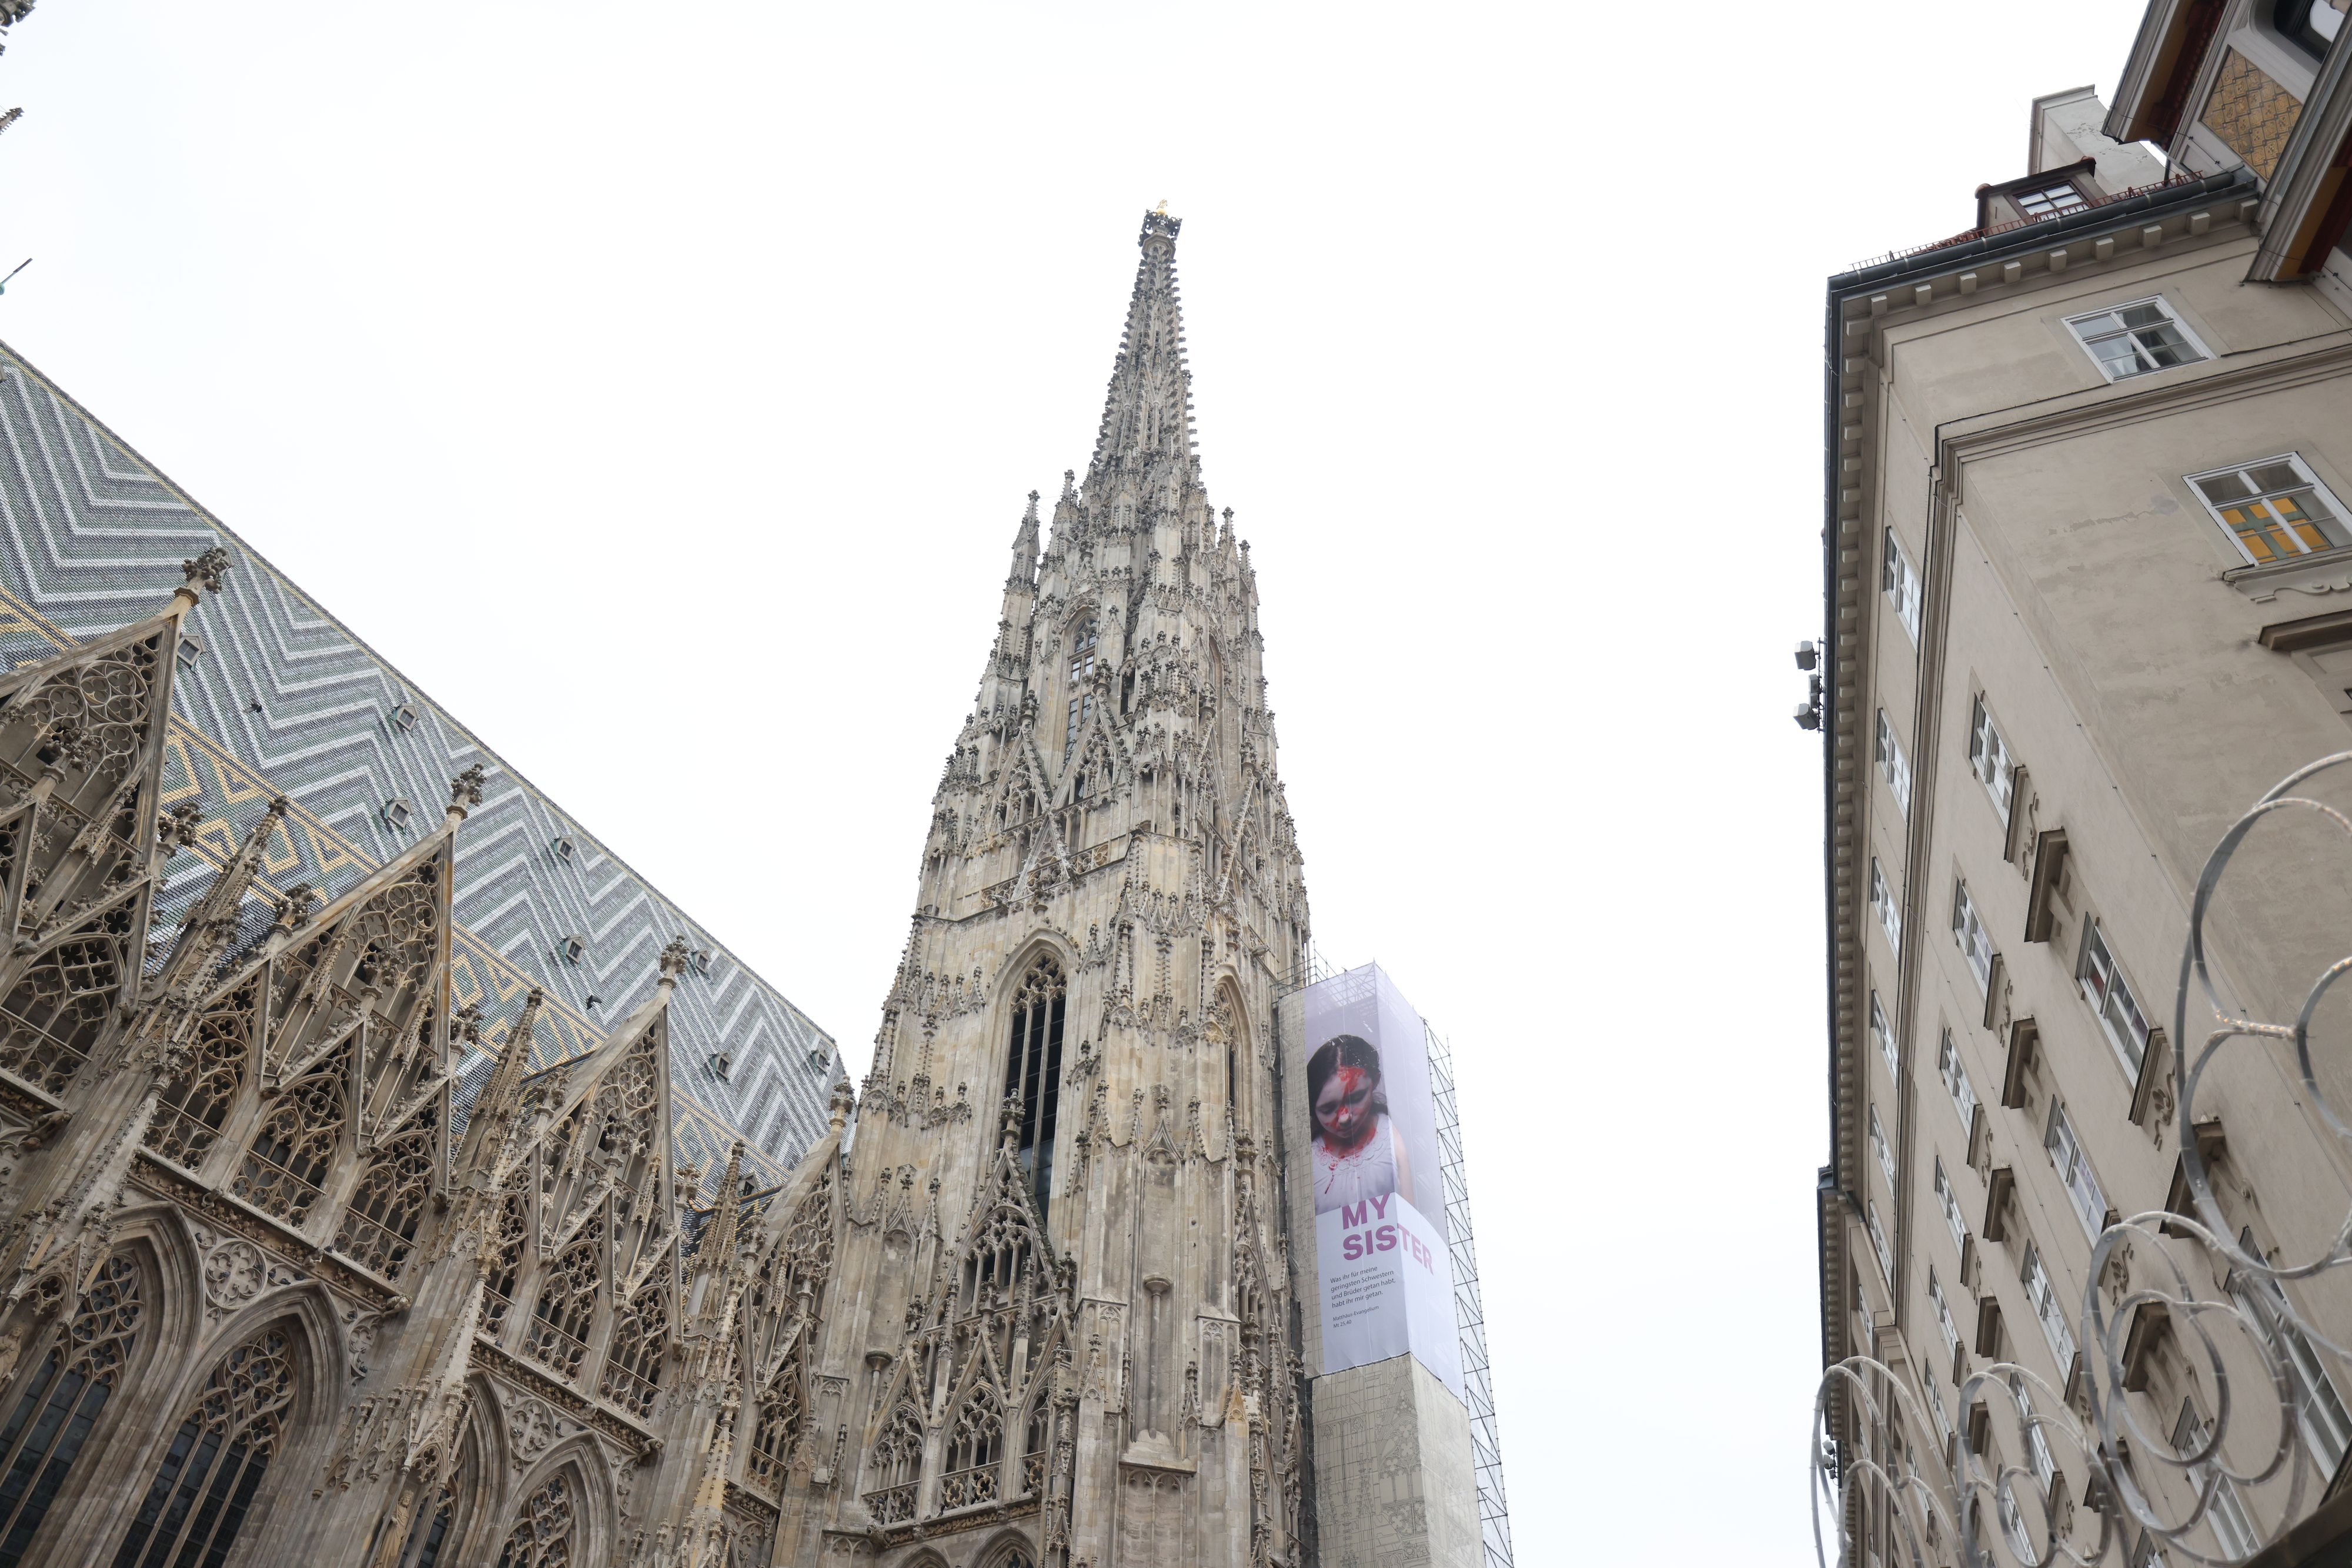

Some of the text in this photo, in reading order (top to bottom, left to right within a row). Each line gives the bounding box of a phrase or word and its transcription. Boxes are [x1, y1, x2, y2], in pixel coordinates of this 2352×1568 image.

[1341, 1192, 1390, 1230] MY
[1343, 1223, 1434, 1275] SISTER
[1360, 1266, 1378, 1275] meine
[1331, 1270, 1394, 1293] geringsten Schwestern
[1344, 1287, 1362, 1296] Brüder
[1363, 1282, 1379, 1292] getan
[1365, 1290, 1383, 1300] getan.
[1332, 1305, 1379, 1321] Matthäus-Evangelium
